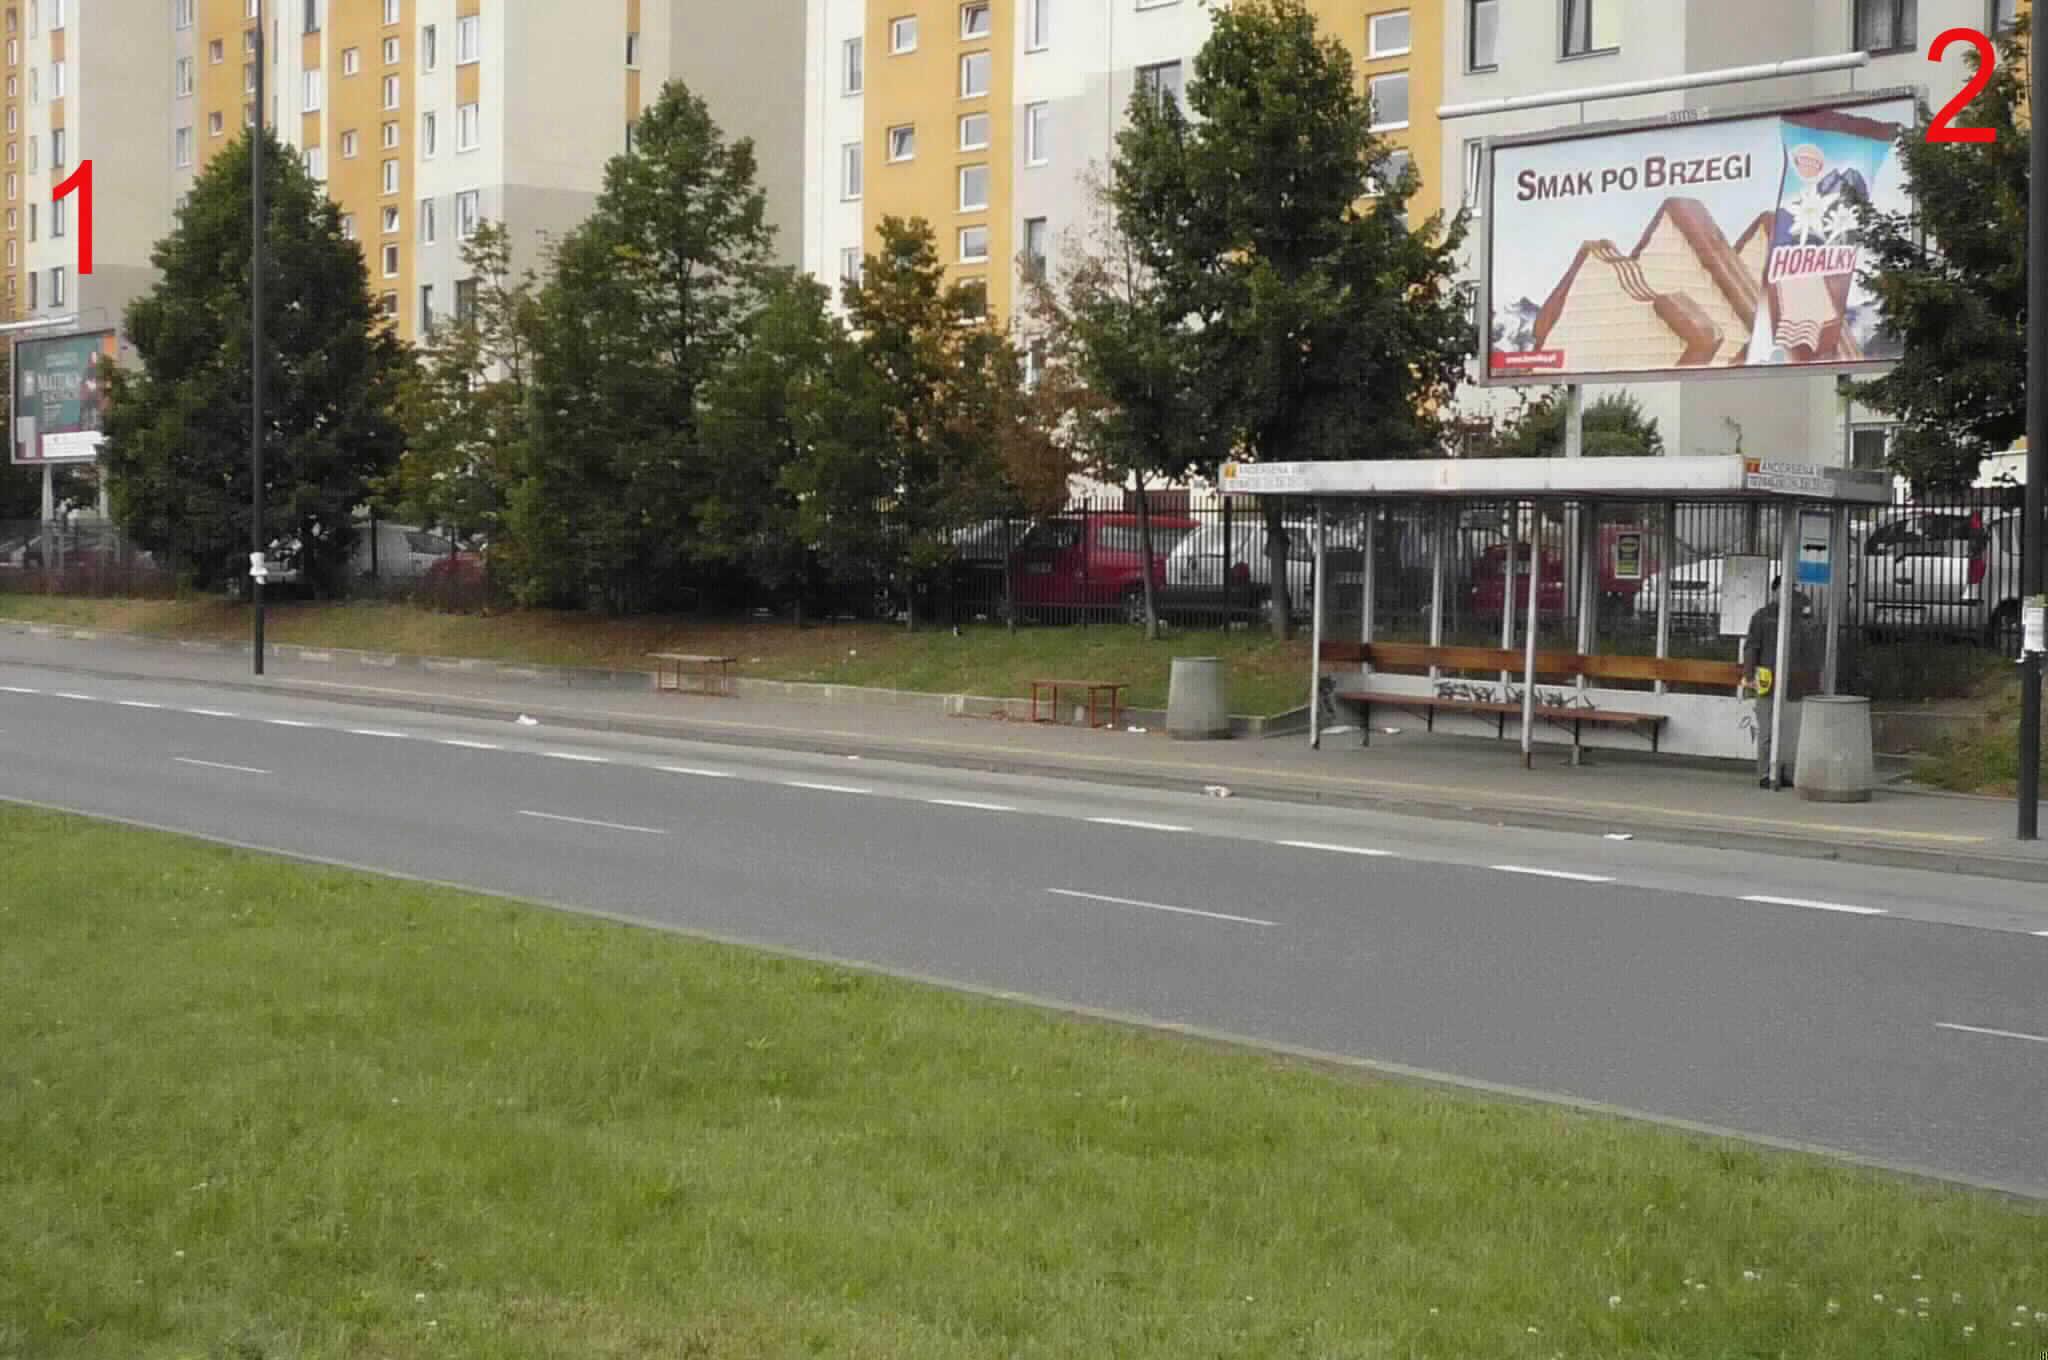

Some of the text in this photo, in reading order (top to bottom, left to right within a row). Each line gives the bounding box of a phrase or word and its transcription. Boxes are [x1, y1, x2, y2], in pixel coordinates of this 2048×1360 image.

[1517, 153, 1751, 201] SMAK PO BRZEGI
[1771, 247, 1857, 281] HORALKY
